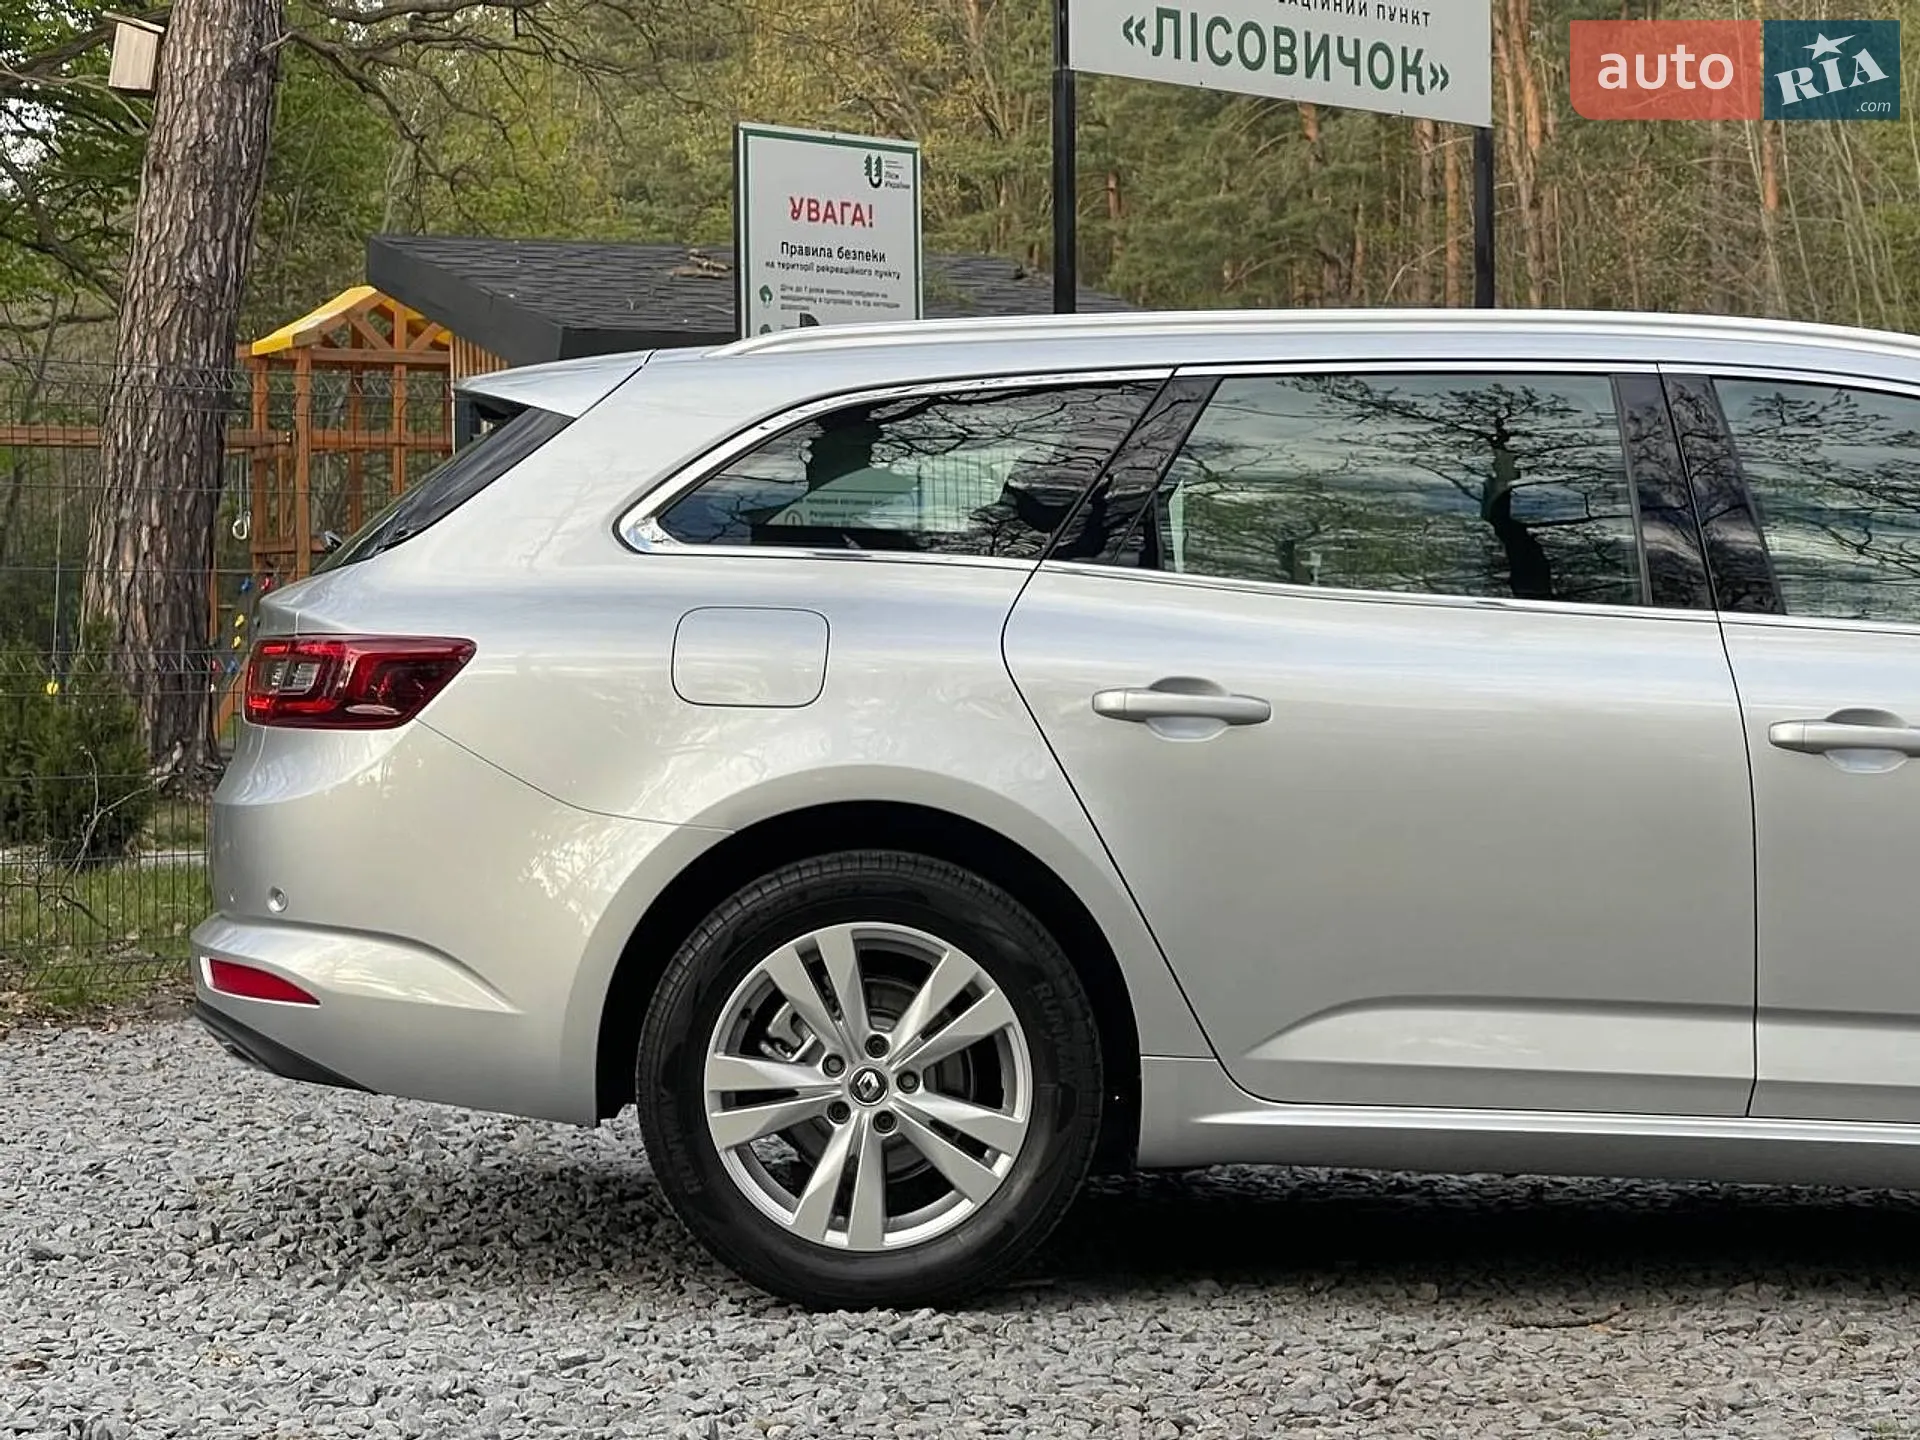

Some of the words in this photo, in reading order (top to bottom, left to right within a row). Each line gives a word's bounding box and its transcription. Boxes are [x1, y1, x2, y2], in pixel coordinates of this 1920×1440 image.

[1377, 4, 1431, 27] ПУНКТ
[1121, 6, 1450, 96] «ЛІСОВИЧОК»
[789, 196, 874, 228] УВАГА!
[781, 241, 833, 258] Правила
[837, 246, 887, 264] безпеки
